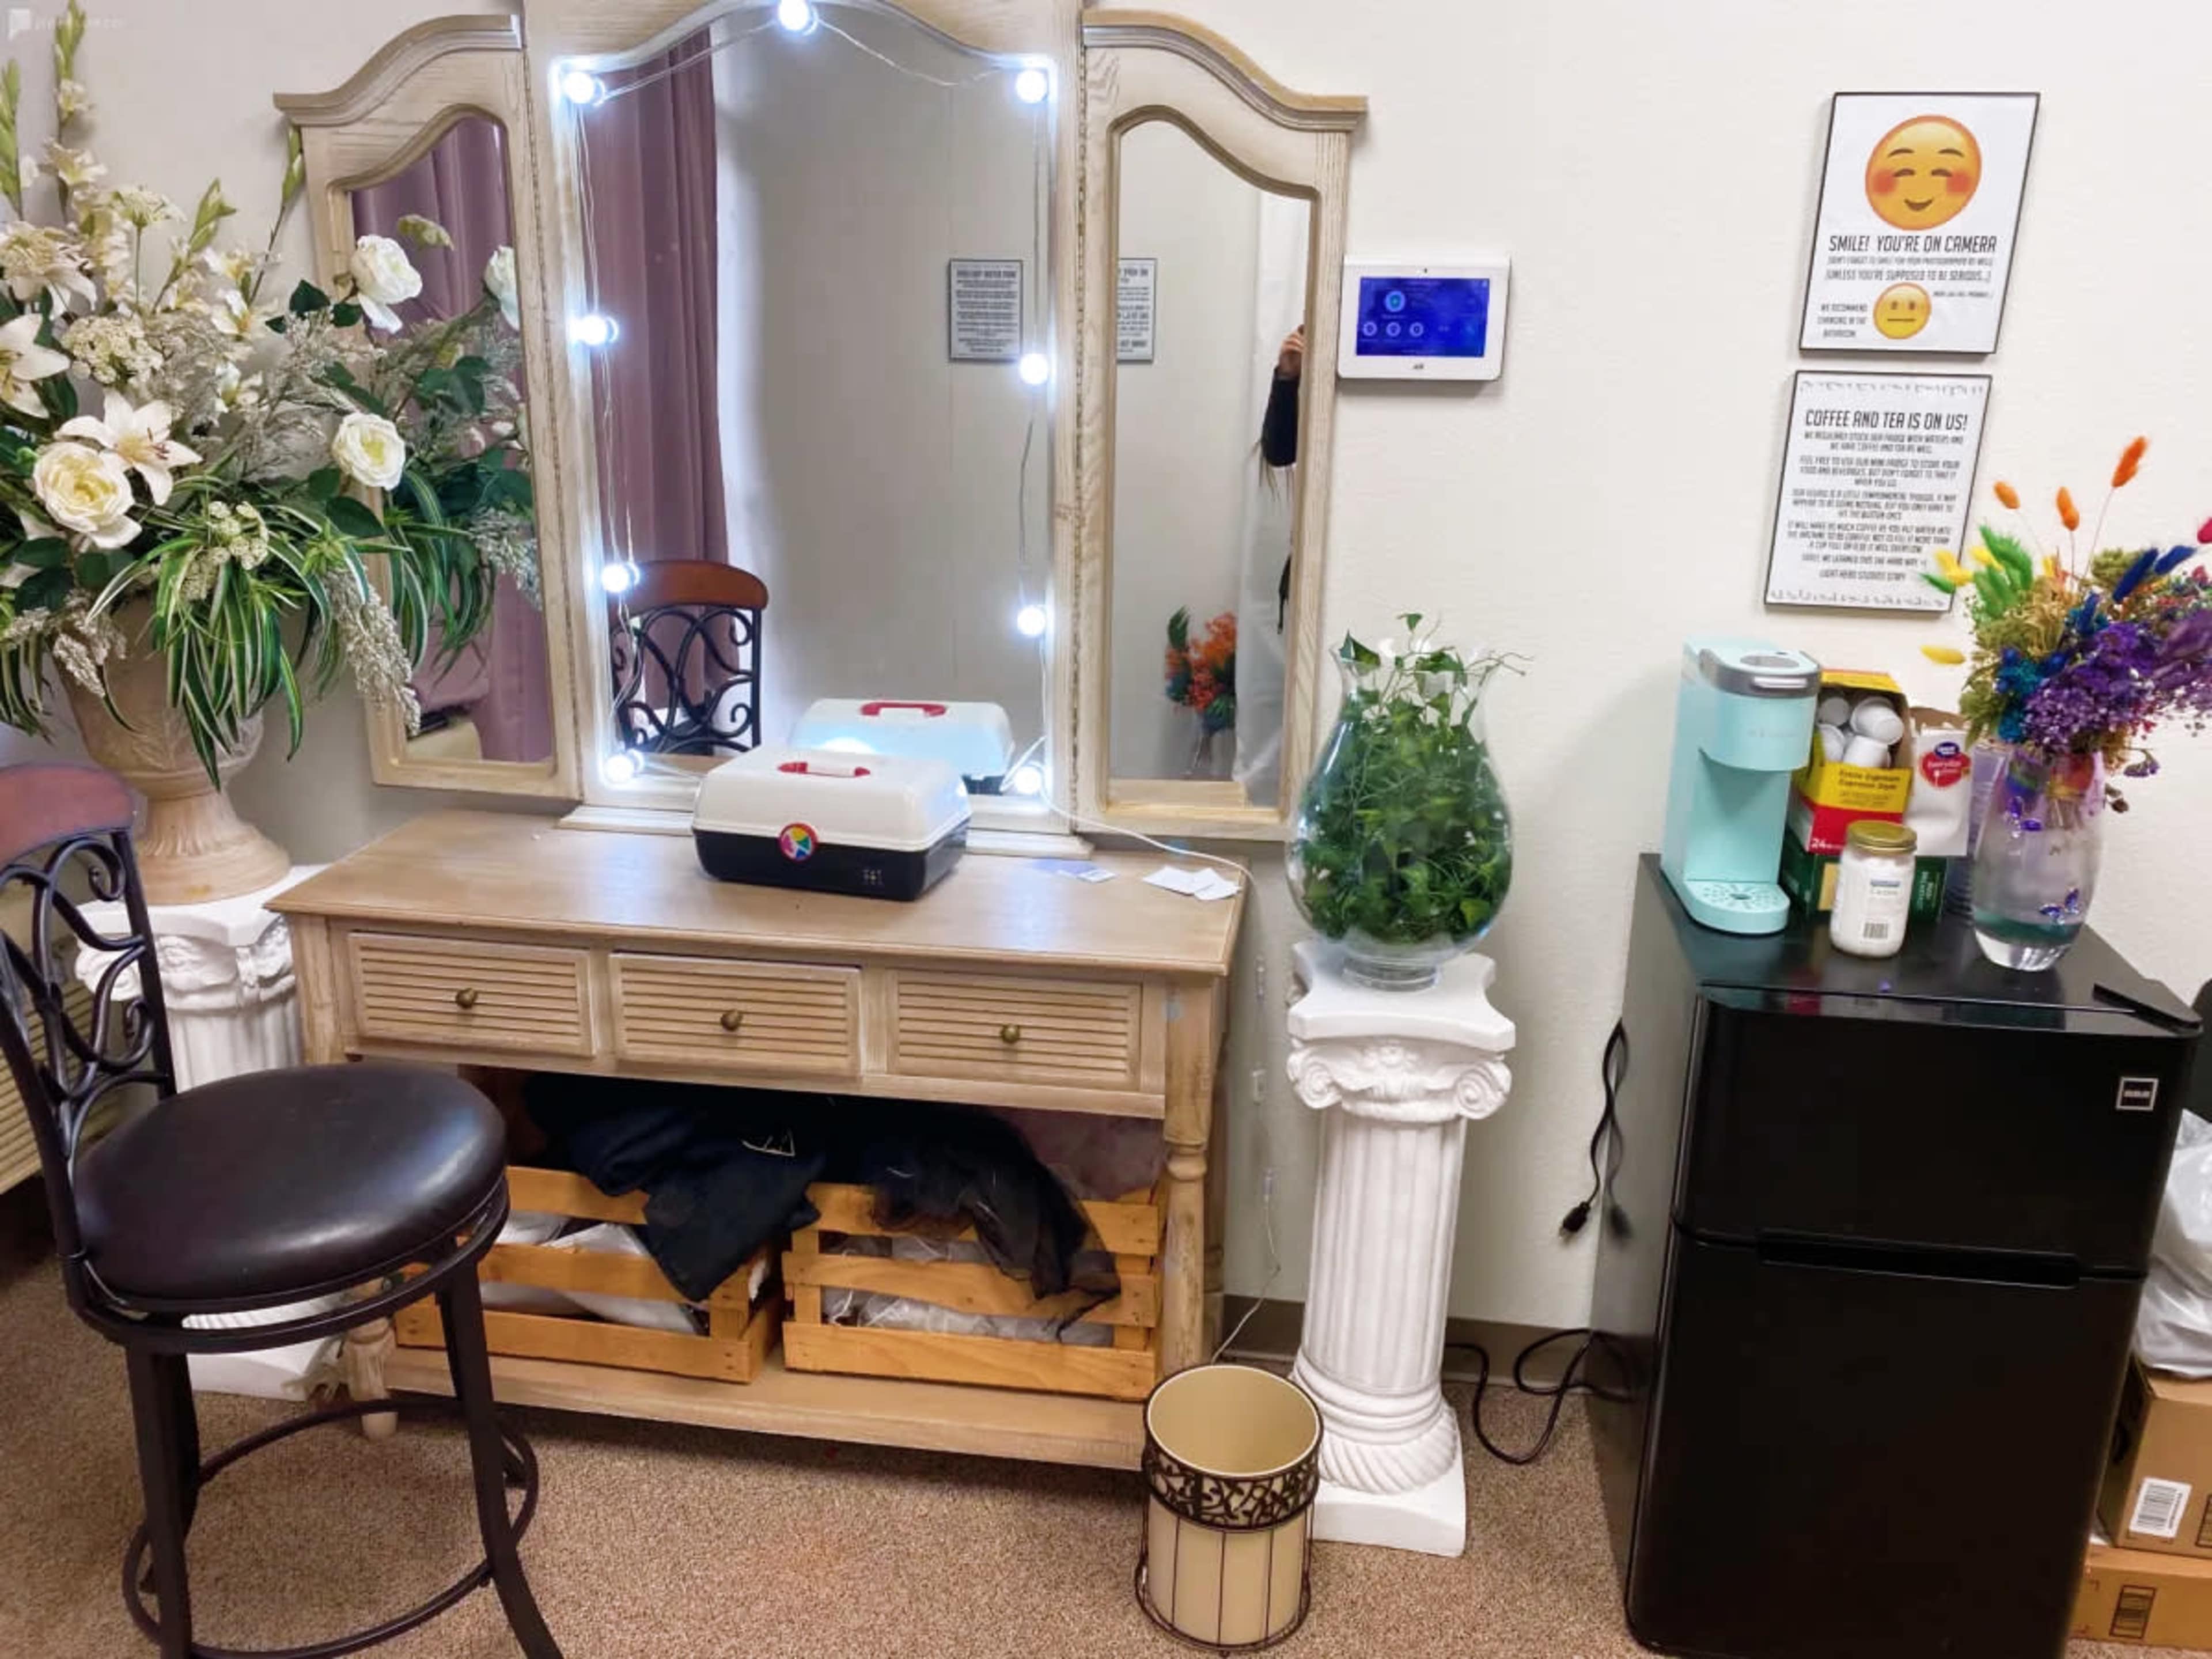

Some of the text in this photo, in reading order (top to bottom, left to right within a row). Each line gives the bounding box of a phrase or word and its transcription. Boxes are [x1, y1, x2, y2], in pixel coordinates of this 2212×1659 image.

[1829, 236, 1997, 253] SMILE! YOU'RE ON CAMERA
[1805, 409, 1968, 431] COFFEE AND TEA IS ON US!
[1811, 837, 1826, 849] 24
